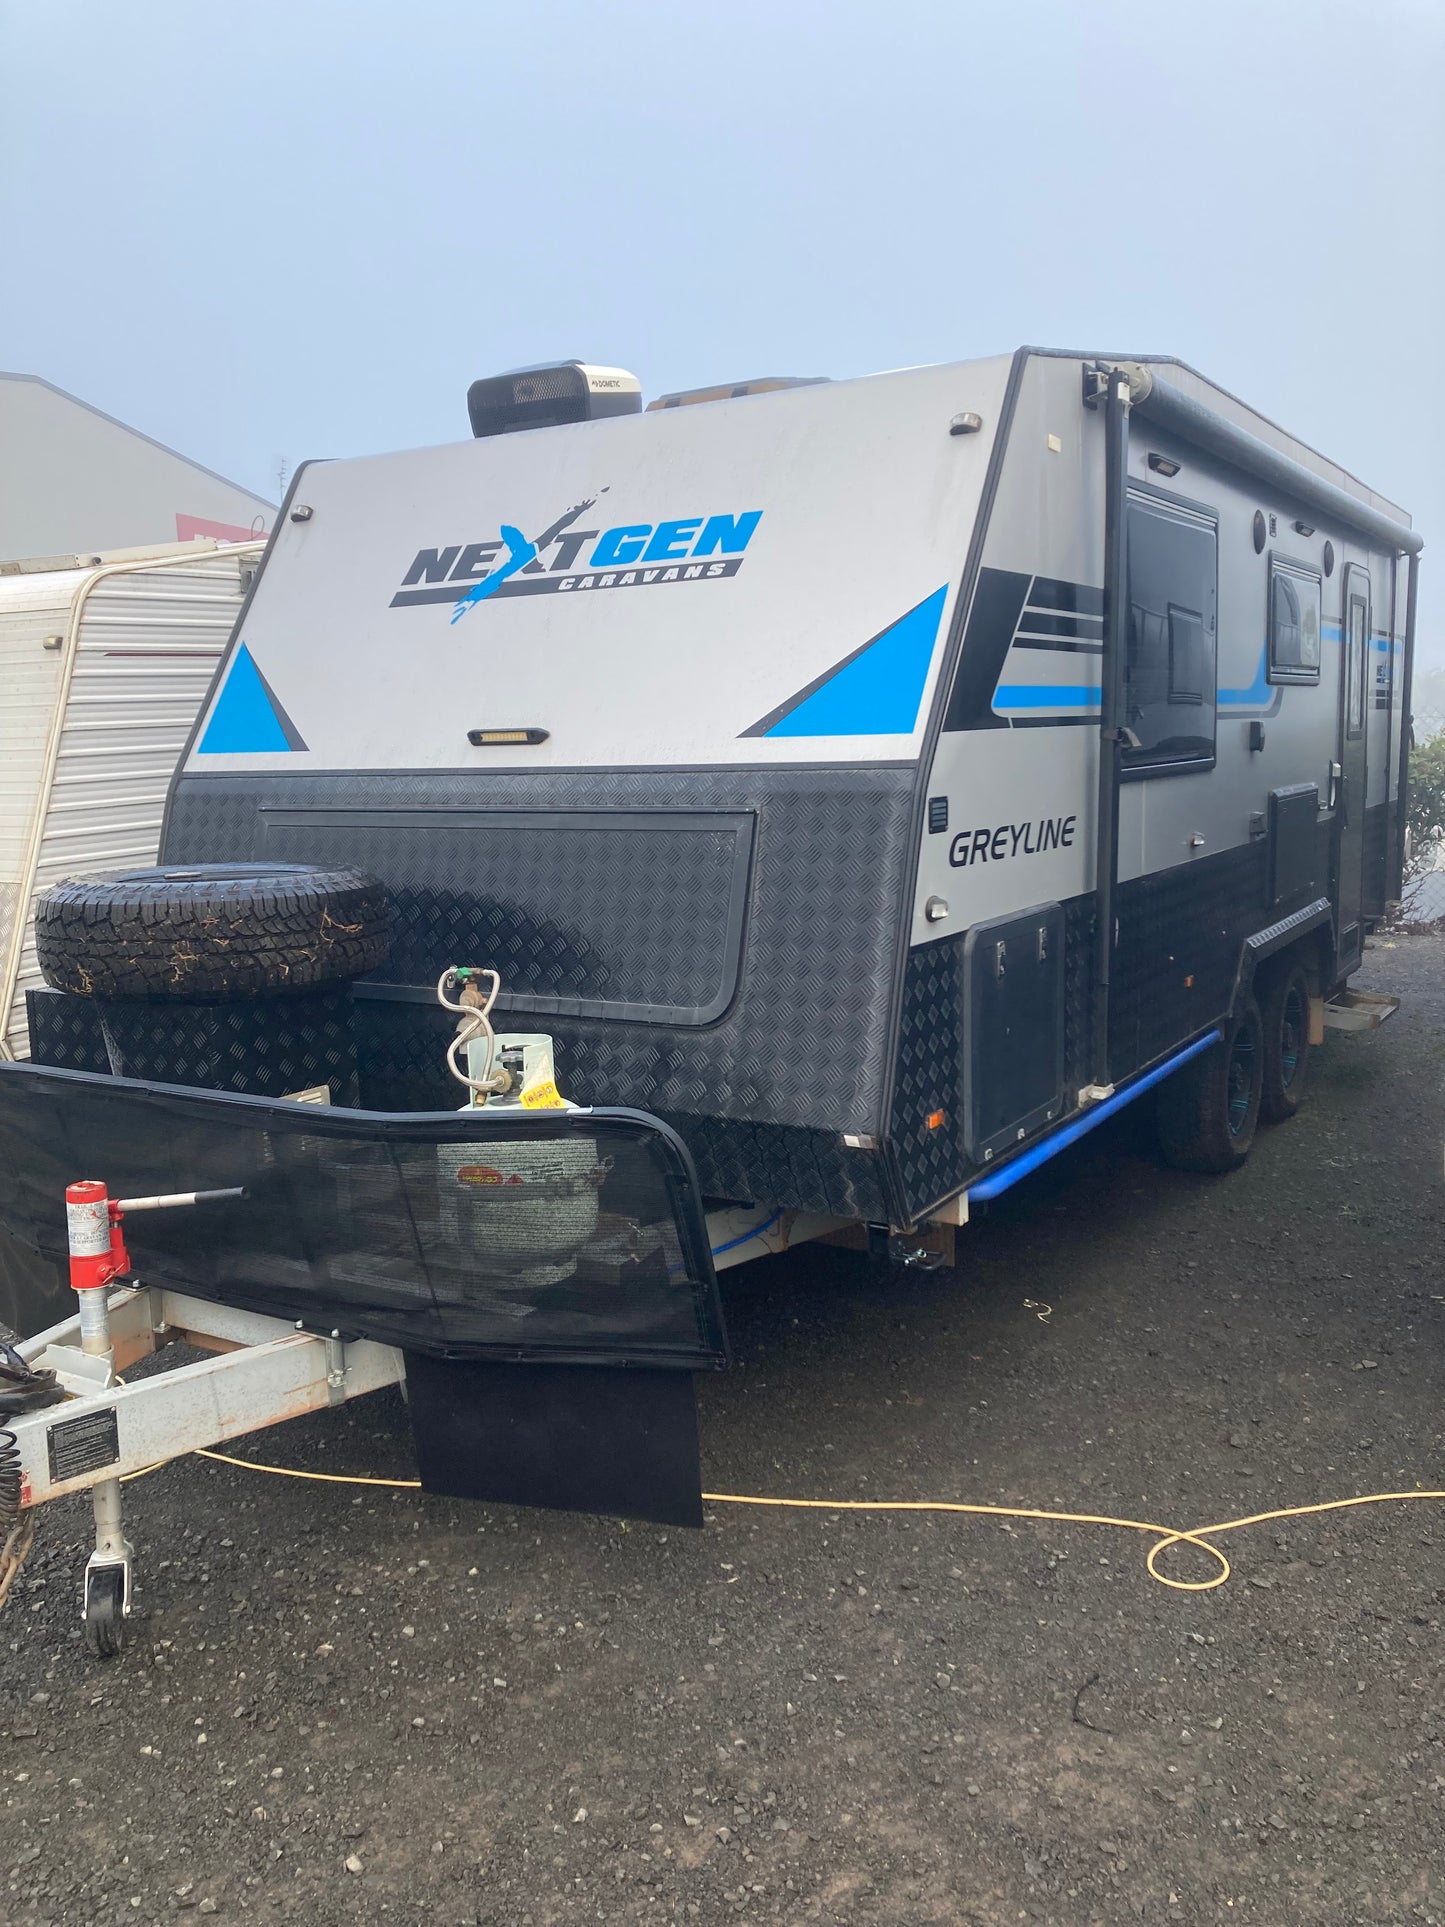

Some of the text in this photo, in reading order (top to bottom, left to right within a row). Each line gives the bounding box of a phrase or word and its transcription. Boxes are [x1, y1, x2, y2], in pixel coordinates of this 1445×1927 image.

[598, 380, 621, 388] DOMETIC
[400, 490, 763, 612] NEXTGEN
[558, 563, 726, 591] CARAVANS
[949, 815, 1076, 868] GREYLINE
